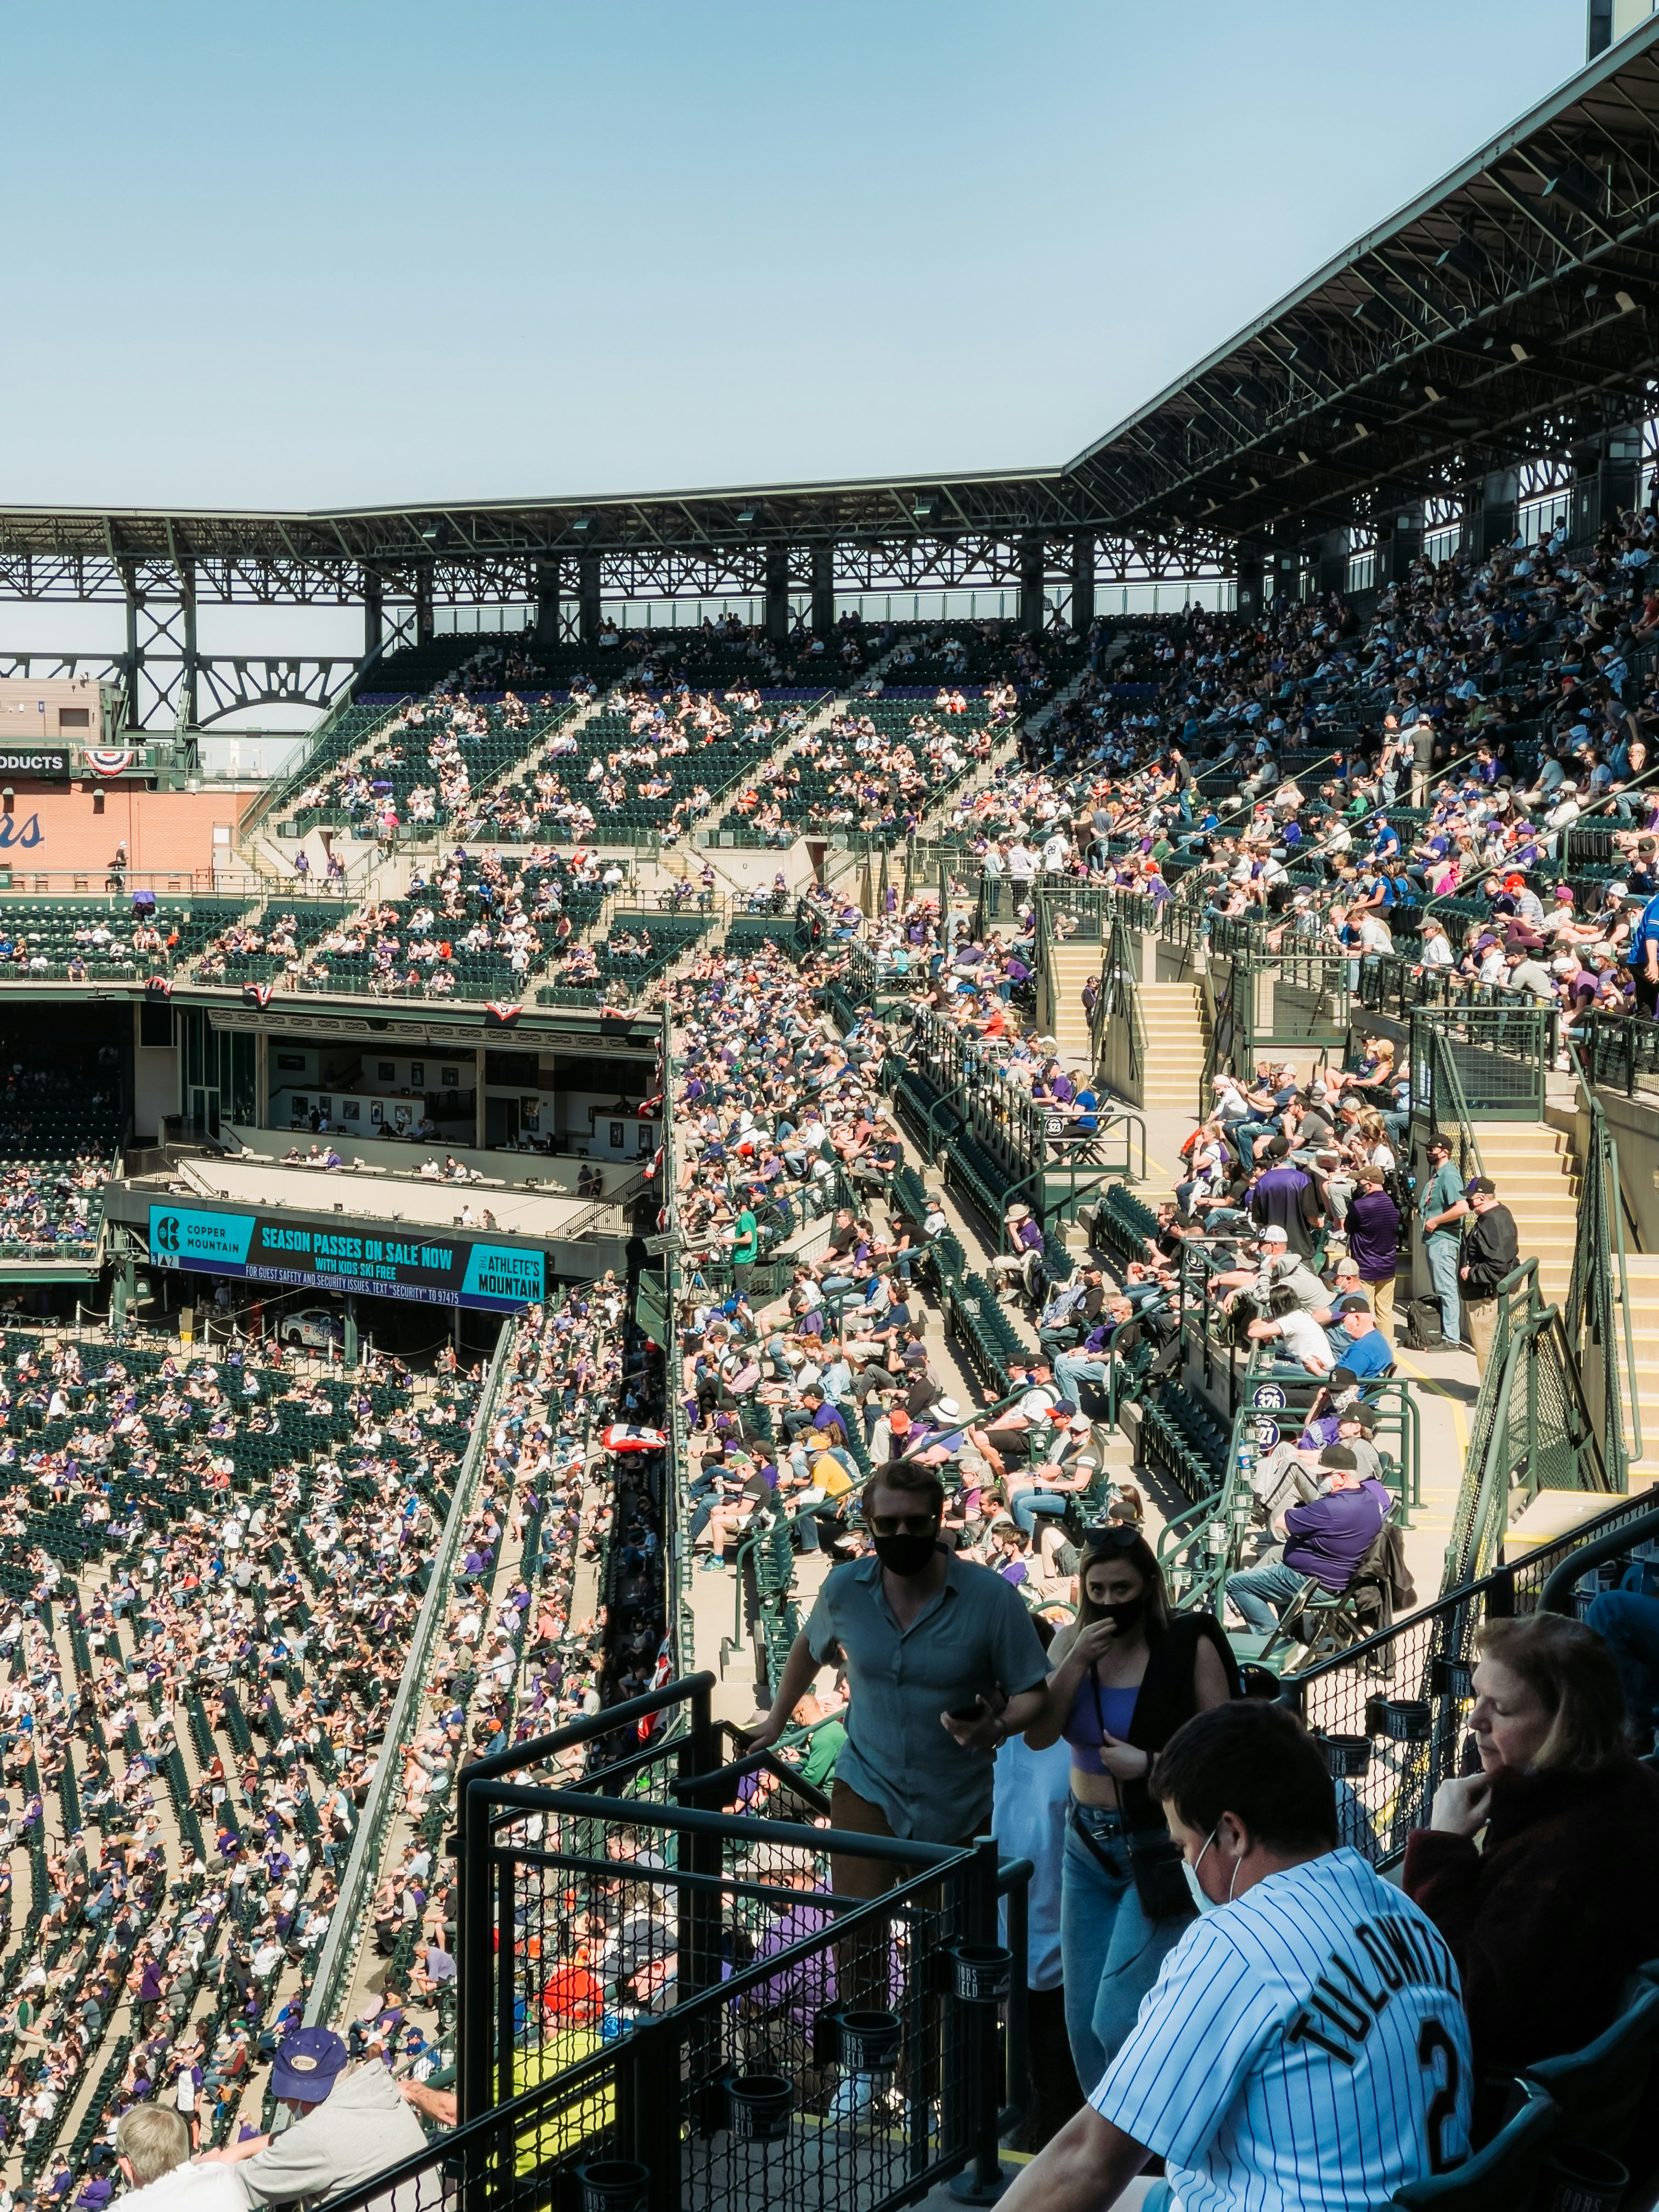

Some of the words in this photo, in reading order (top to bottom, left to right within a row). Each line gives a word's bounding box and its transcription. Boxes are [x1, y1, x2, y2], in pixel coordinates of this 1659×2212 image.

[1048, 845, 1056, 855] 28
[1048, 1122, 1061, 1132] 323
[188, 1225, 225, 1238] COPPER
[188, 1239, 239, 1253] MOUNTAIN
[262, 1227, 310, 1252] SEASON
[314, 1234, 362, 1259] PASSES
[365, 1240, 382, 1261] ON
[386, 1243, 418, 1266] SALE
[422, 1246, 453, 1270] NOW
[170, 1255, 173, 1266] 2
[315, 1257, 336, 1272] WITH
[338, 1260, 357, 1275] KIDS
[360, 1263, 374, 1277] SKI
[376, 1265, 396, 1280] FREE
[488, 1256, 539, 1277] ATHLETE'S
[246, 1266, 257, 1277] FOR
[259, 1267, 278, 1280] GUEST
[279, 1269, 302, 1283] SAFETY
[303, 1273, 315, 1285] AND
[317, 1275, 347, 1289] SECURITY
[348, 1278, 371, 1293] ISSUES,
[373, 1282, 388, 1294] TEXT
[389, 1284, 427, 1299] "SECURITY"
[428, 1290, 436, 1302] TO
[438, 1291, 459, 1304] 97475
[478, 1273, 540, 1299] MOUNTAIN
[1258, 1394, 1280, 1408] 326
[1259, 1426, 1274, 1444] 27
[1418, 2015, 1469, 2176] 2
